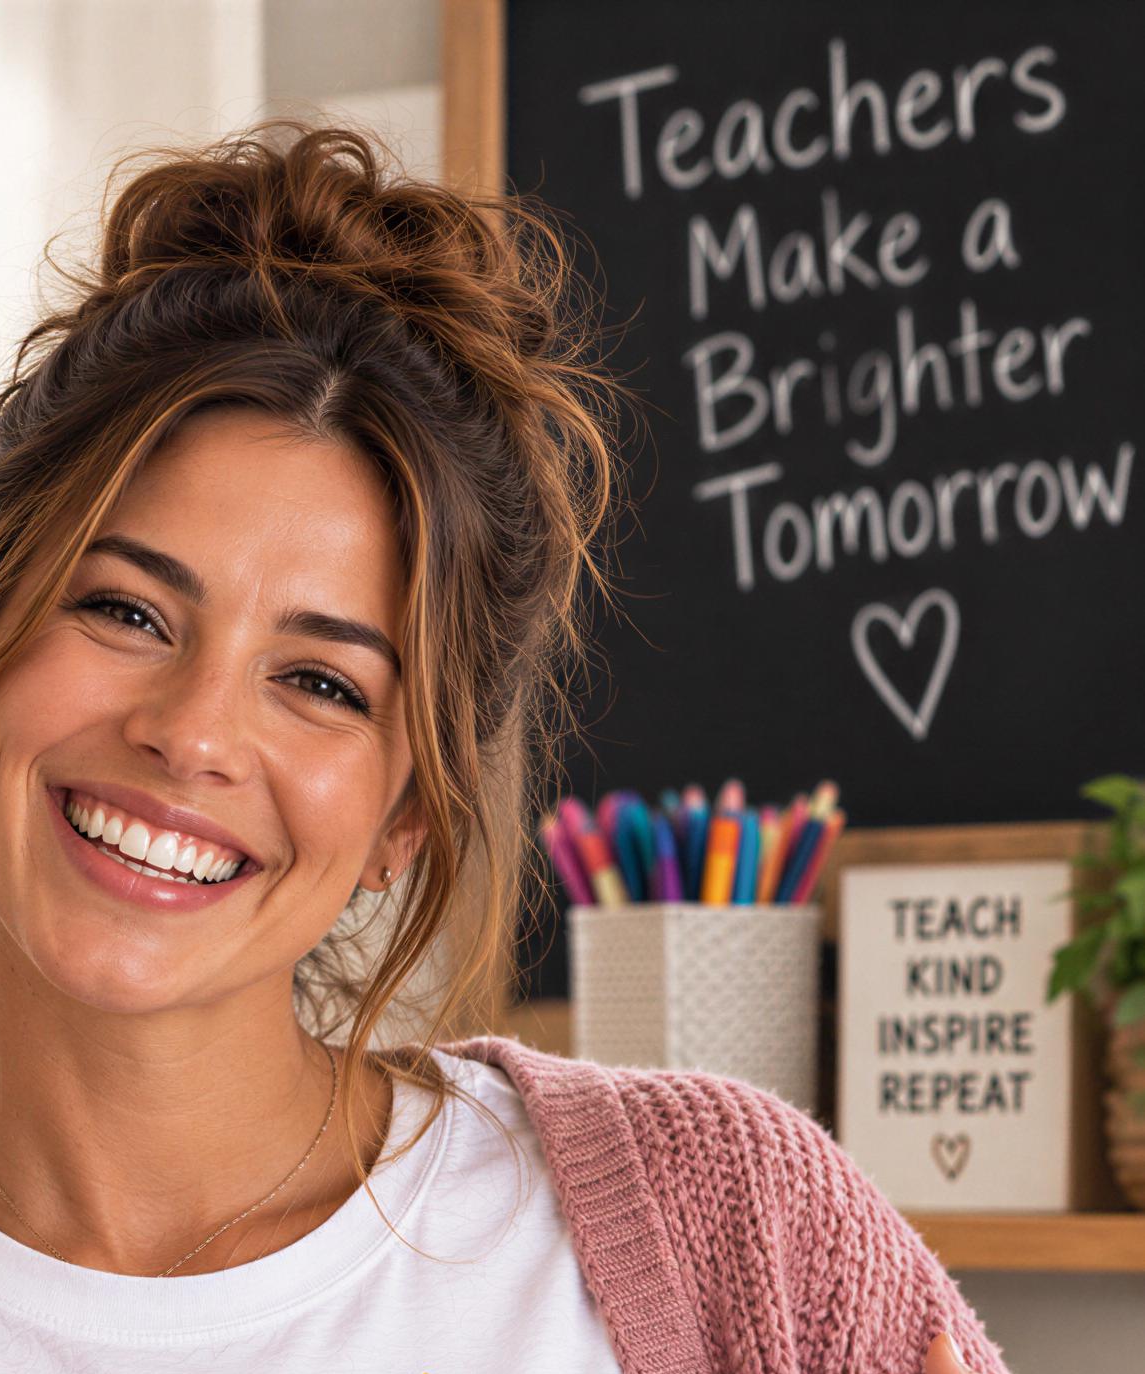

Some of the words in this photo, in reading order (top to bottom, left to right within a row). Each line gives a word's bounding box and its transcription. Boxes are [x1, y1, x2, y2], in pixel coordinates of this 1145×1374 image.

[578, 37, 1066, 198] Teachers
[689, 188, 930, 320] Make
[962, 199, 1021, 273] a
[684, 299, 1092, 467] Brighter
[693, 441, 1135, 592] Tomorrow
[889, 897, 1021, 941] TEACH
[906, 956, 1003, 996] KIND
[878, 1012, 1034, 1056] INSPIRE
[879, 1072, 1032, 1114] REPEAT
